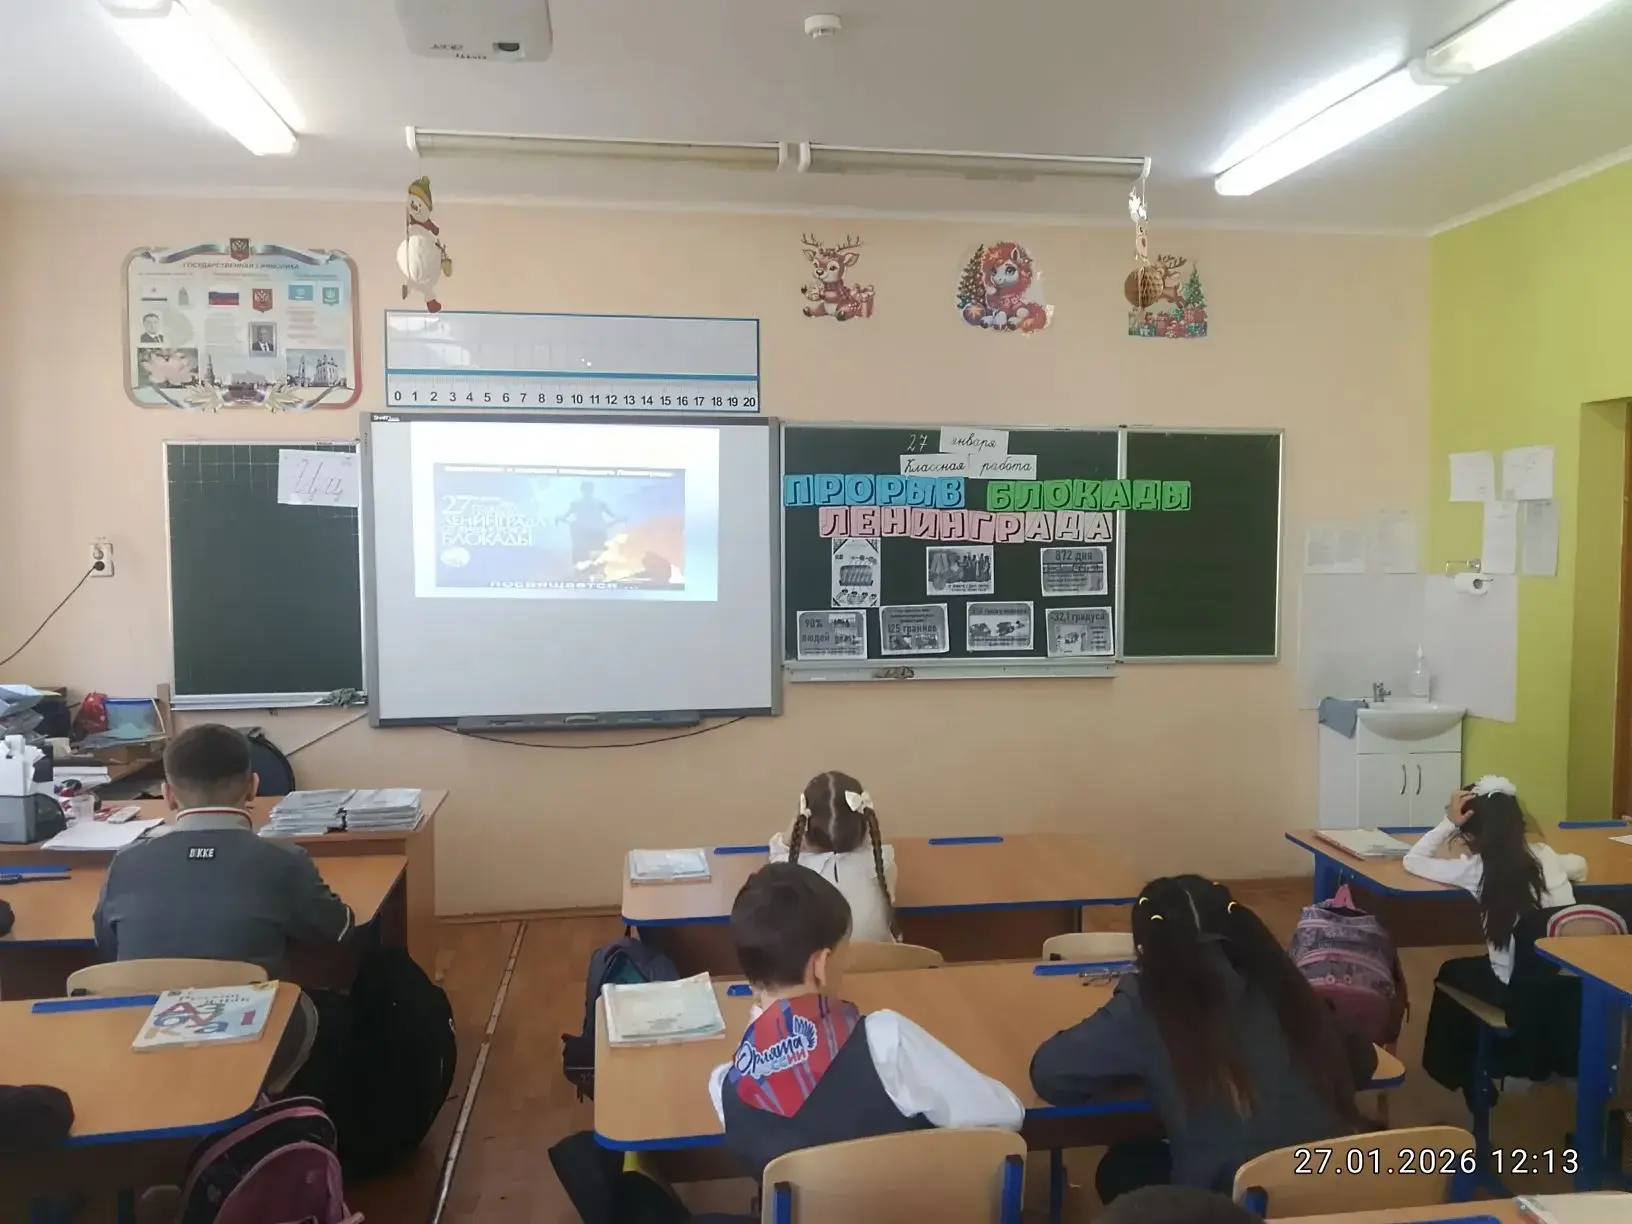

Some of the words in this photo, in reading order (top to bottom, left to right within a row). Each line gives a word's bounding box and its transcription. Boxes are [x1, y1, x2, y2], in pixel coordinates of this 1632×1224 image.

[394, 391, 401, 401] 0
[412, 392, 418, 401] 1
[430, 392, 438, 402] 2
[449, 392, 457, 402] 3
[466, 392, 473, 402] 4
[484, 392, 491, 402] 5
[502, 393, 510, 402] 6
[520, 393, 527, 402] 7
[538, 393, 546, 403] 8
[556, 394, 563, 404] 9
[571, 394, 583, 404] 10
[589, 394, 600, 404] 11
[605, 394, 618, 405] 12
[623, 395, 636, 405] 13
[641, 395, 653, 406] 14
[660, 396, 671, 406] 15
[676, 396, 688, 406] 16
[694, 396, 705, 406] 17
[711, 396, 723, 407] 18
[727, 397, 738, 407] 19
[743, 397, 756, 407] 20
[907, 433, 928, 452] 27
[951, 432, 997, 453] января
[904, 458, 966, 473] Классная
[979, 456, 1032, 477] работа
[785, 475, 963, 507] ПРОРЫВ
[987, 480, 1191, 510] БЛОКАДЫ
[442, 494, 472, 515] 27
[820, 507, 1113, 542] ЛЕНИНГРАДА
[442, 532, 534, 547] БЛОКАДЫ
[1055, 549, 1073, 561] 872
[1075, 551, 1093, 562] дня
[804, 618, 823, 629] 90%
[887, 623, 901, 634] 125
[736, 1035, 804, 1074] Орлята
